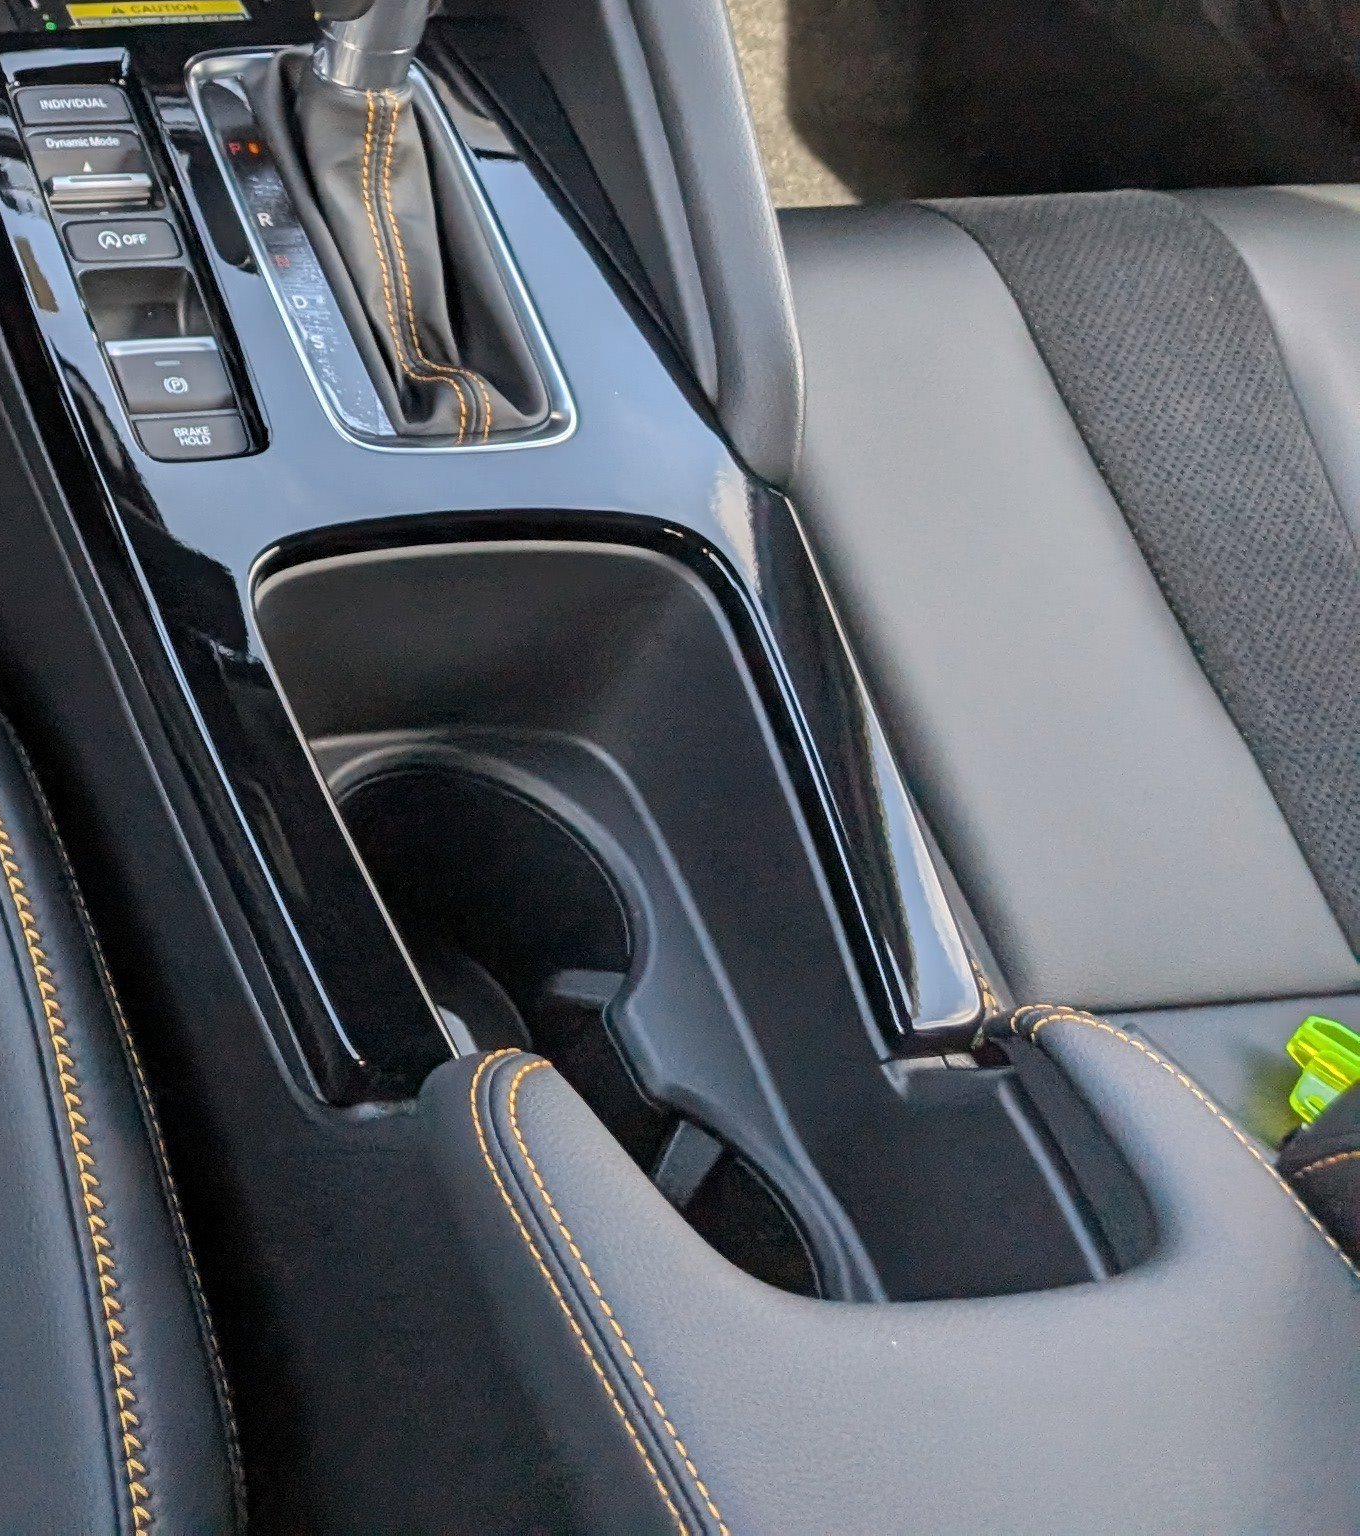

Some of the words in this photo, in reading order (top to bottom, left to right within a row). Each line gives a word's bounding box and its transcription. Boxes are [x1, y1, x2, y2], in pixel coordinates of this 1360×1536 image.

[130, 3, 200, 14] CAUTION
[40, 97, 108, 111] INDIVIDUAL
[45, 137, 89, 149] Dynamic
[89, 136, 120, 147] Mode
[256, 212, 274, 227] R
[122, 233, 148, 245] OFF
[292, 294, 308, 310] D
[310, 334, 326, 350] S
[172, 426, 211, 438] BRAKE
[179, 436, 212, 447] HOLD
